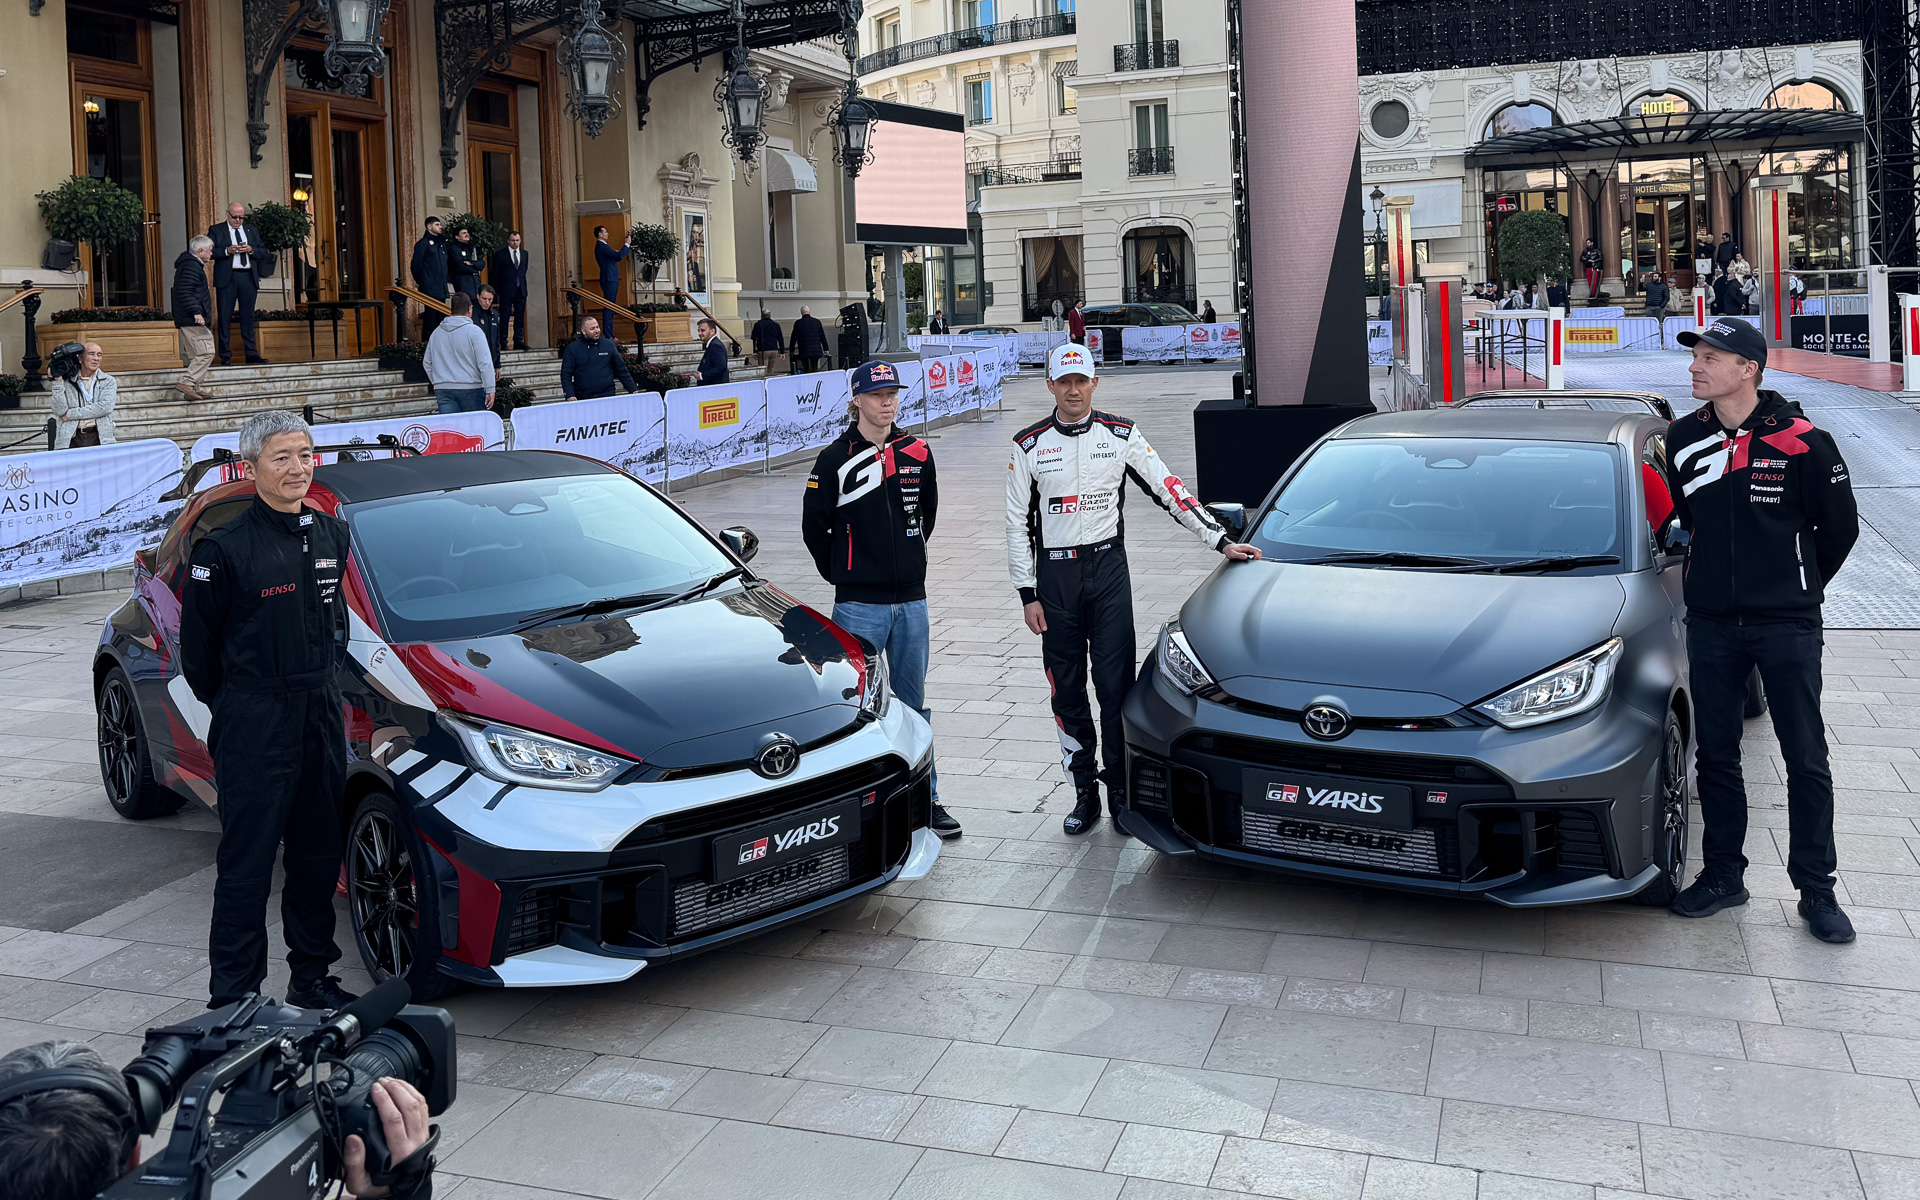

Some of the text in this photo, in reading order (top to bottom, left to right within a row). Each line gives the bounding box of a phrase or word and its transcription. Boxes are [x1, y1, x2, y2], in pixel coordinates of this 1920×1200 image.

[1641, 101, 1678, 115] HOTEL
[1635, 185, 1657, 193] HOTEL
[775, 281, 796, 290] GRAFF
[1569, 330, 1613, 340] PIRELLI
[702, 402, 736, 424] PIRELLI
[555, 420, 628, 443] FANATEC
[1037, 447, 1062, 456] DENSO
[1036, 458, 1063, 466] Panasonic
[1751, 473, 1785, 481] DENSO
[1750, 484, 1784, 492] Panasonic
[1081, 492, 1112, 500] TOYOTA
[1049, 503, 1076, 513] GR
[299, 516, 313, 524] OMP
[191, 566, 211, 580] OMP
[261, 583, 296, 597] DENSO
[1267, 790, 1297, 802] GR
[1428, 795, 1446, 803] GR
[740, 845, 766, 862] GR
[290, 1141, 319, 1176] Panasonic
[308, 1161, 318, 1187] 4
